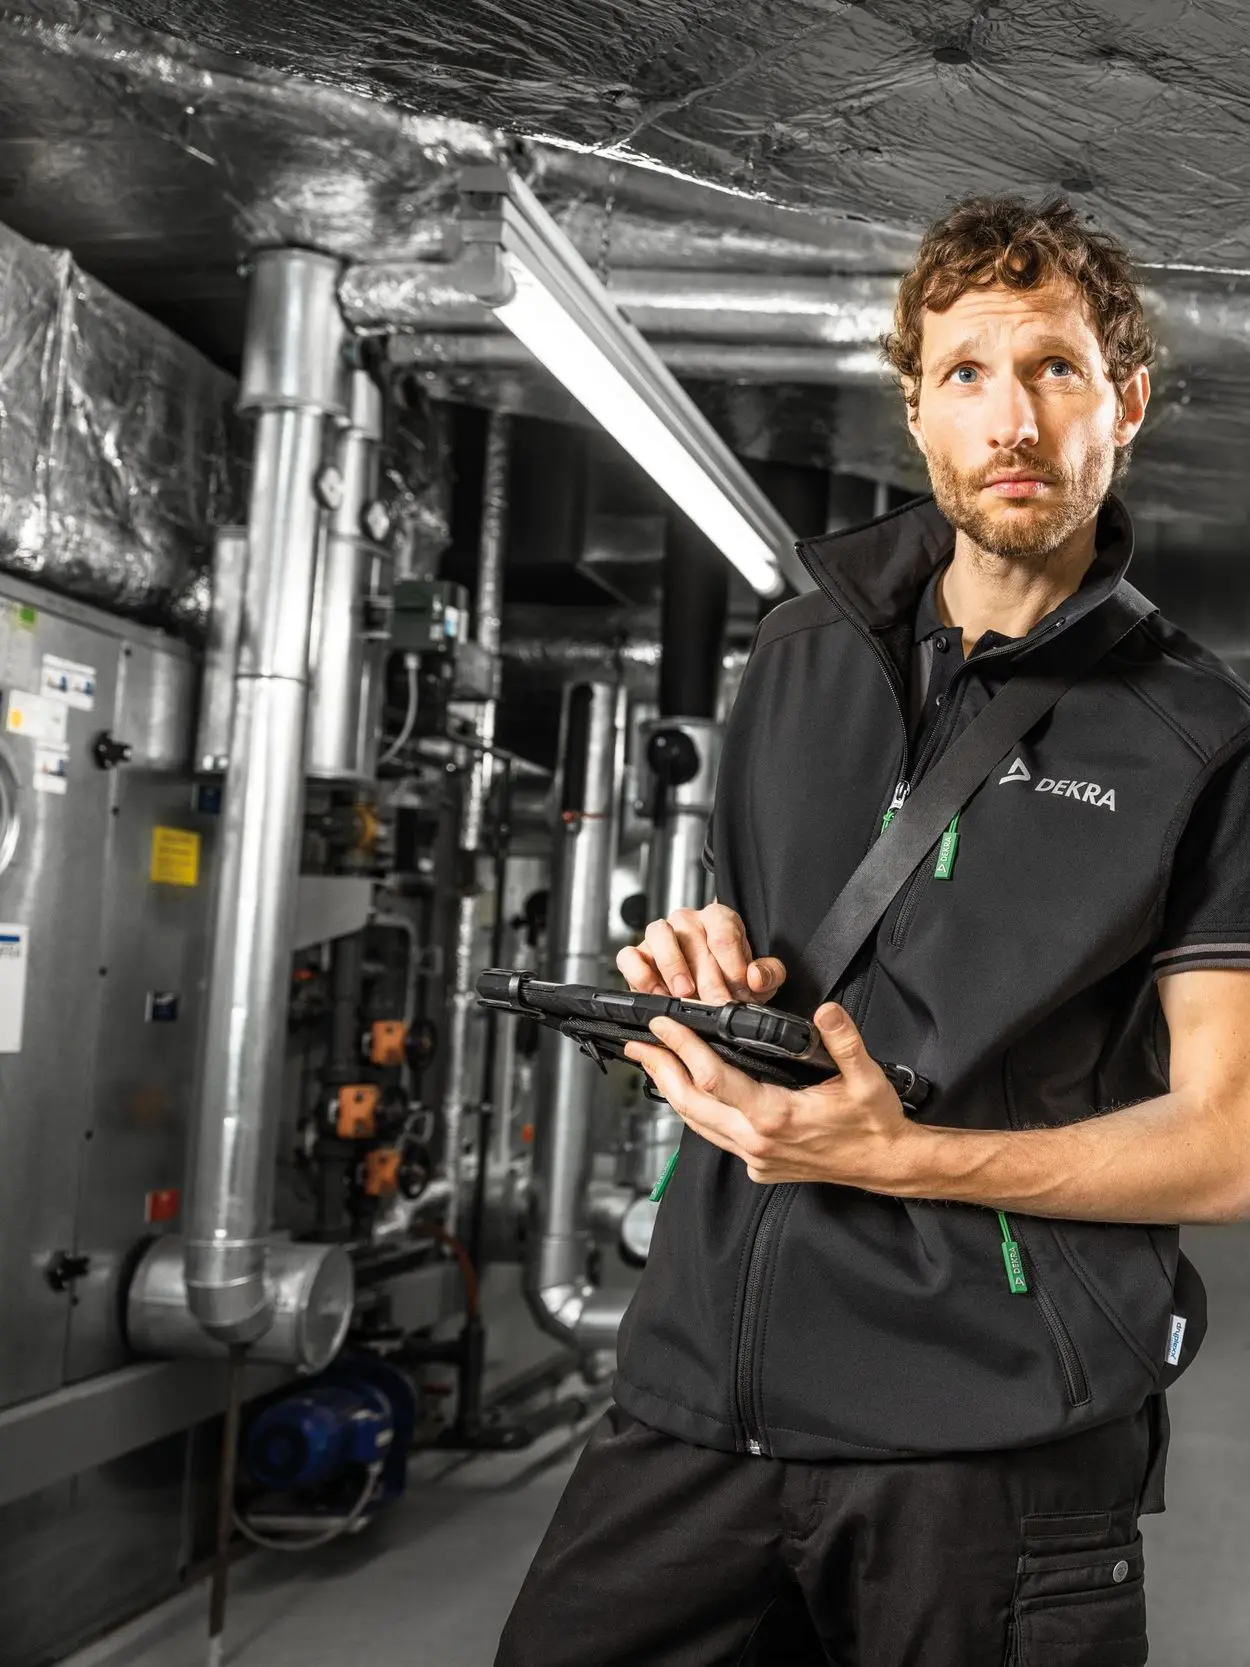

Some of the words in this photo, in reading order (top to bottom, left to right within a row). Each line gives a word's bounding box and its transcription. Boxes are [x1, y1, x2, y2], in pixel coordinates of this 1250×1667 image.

[1034, 777, 1116, 812] DEKRA
[940, 836, 952, 862] DEKRA
[1009, 1247, 1020, 1274] DEKRA
[1171, 1322, 1182, 1360] dryplexx
